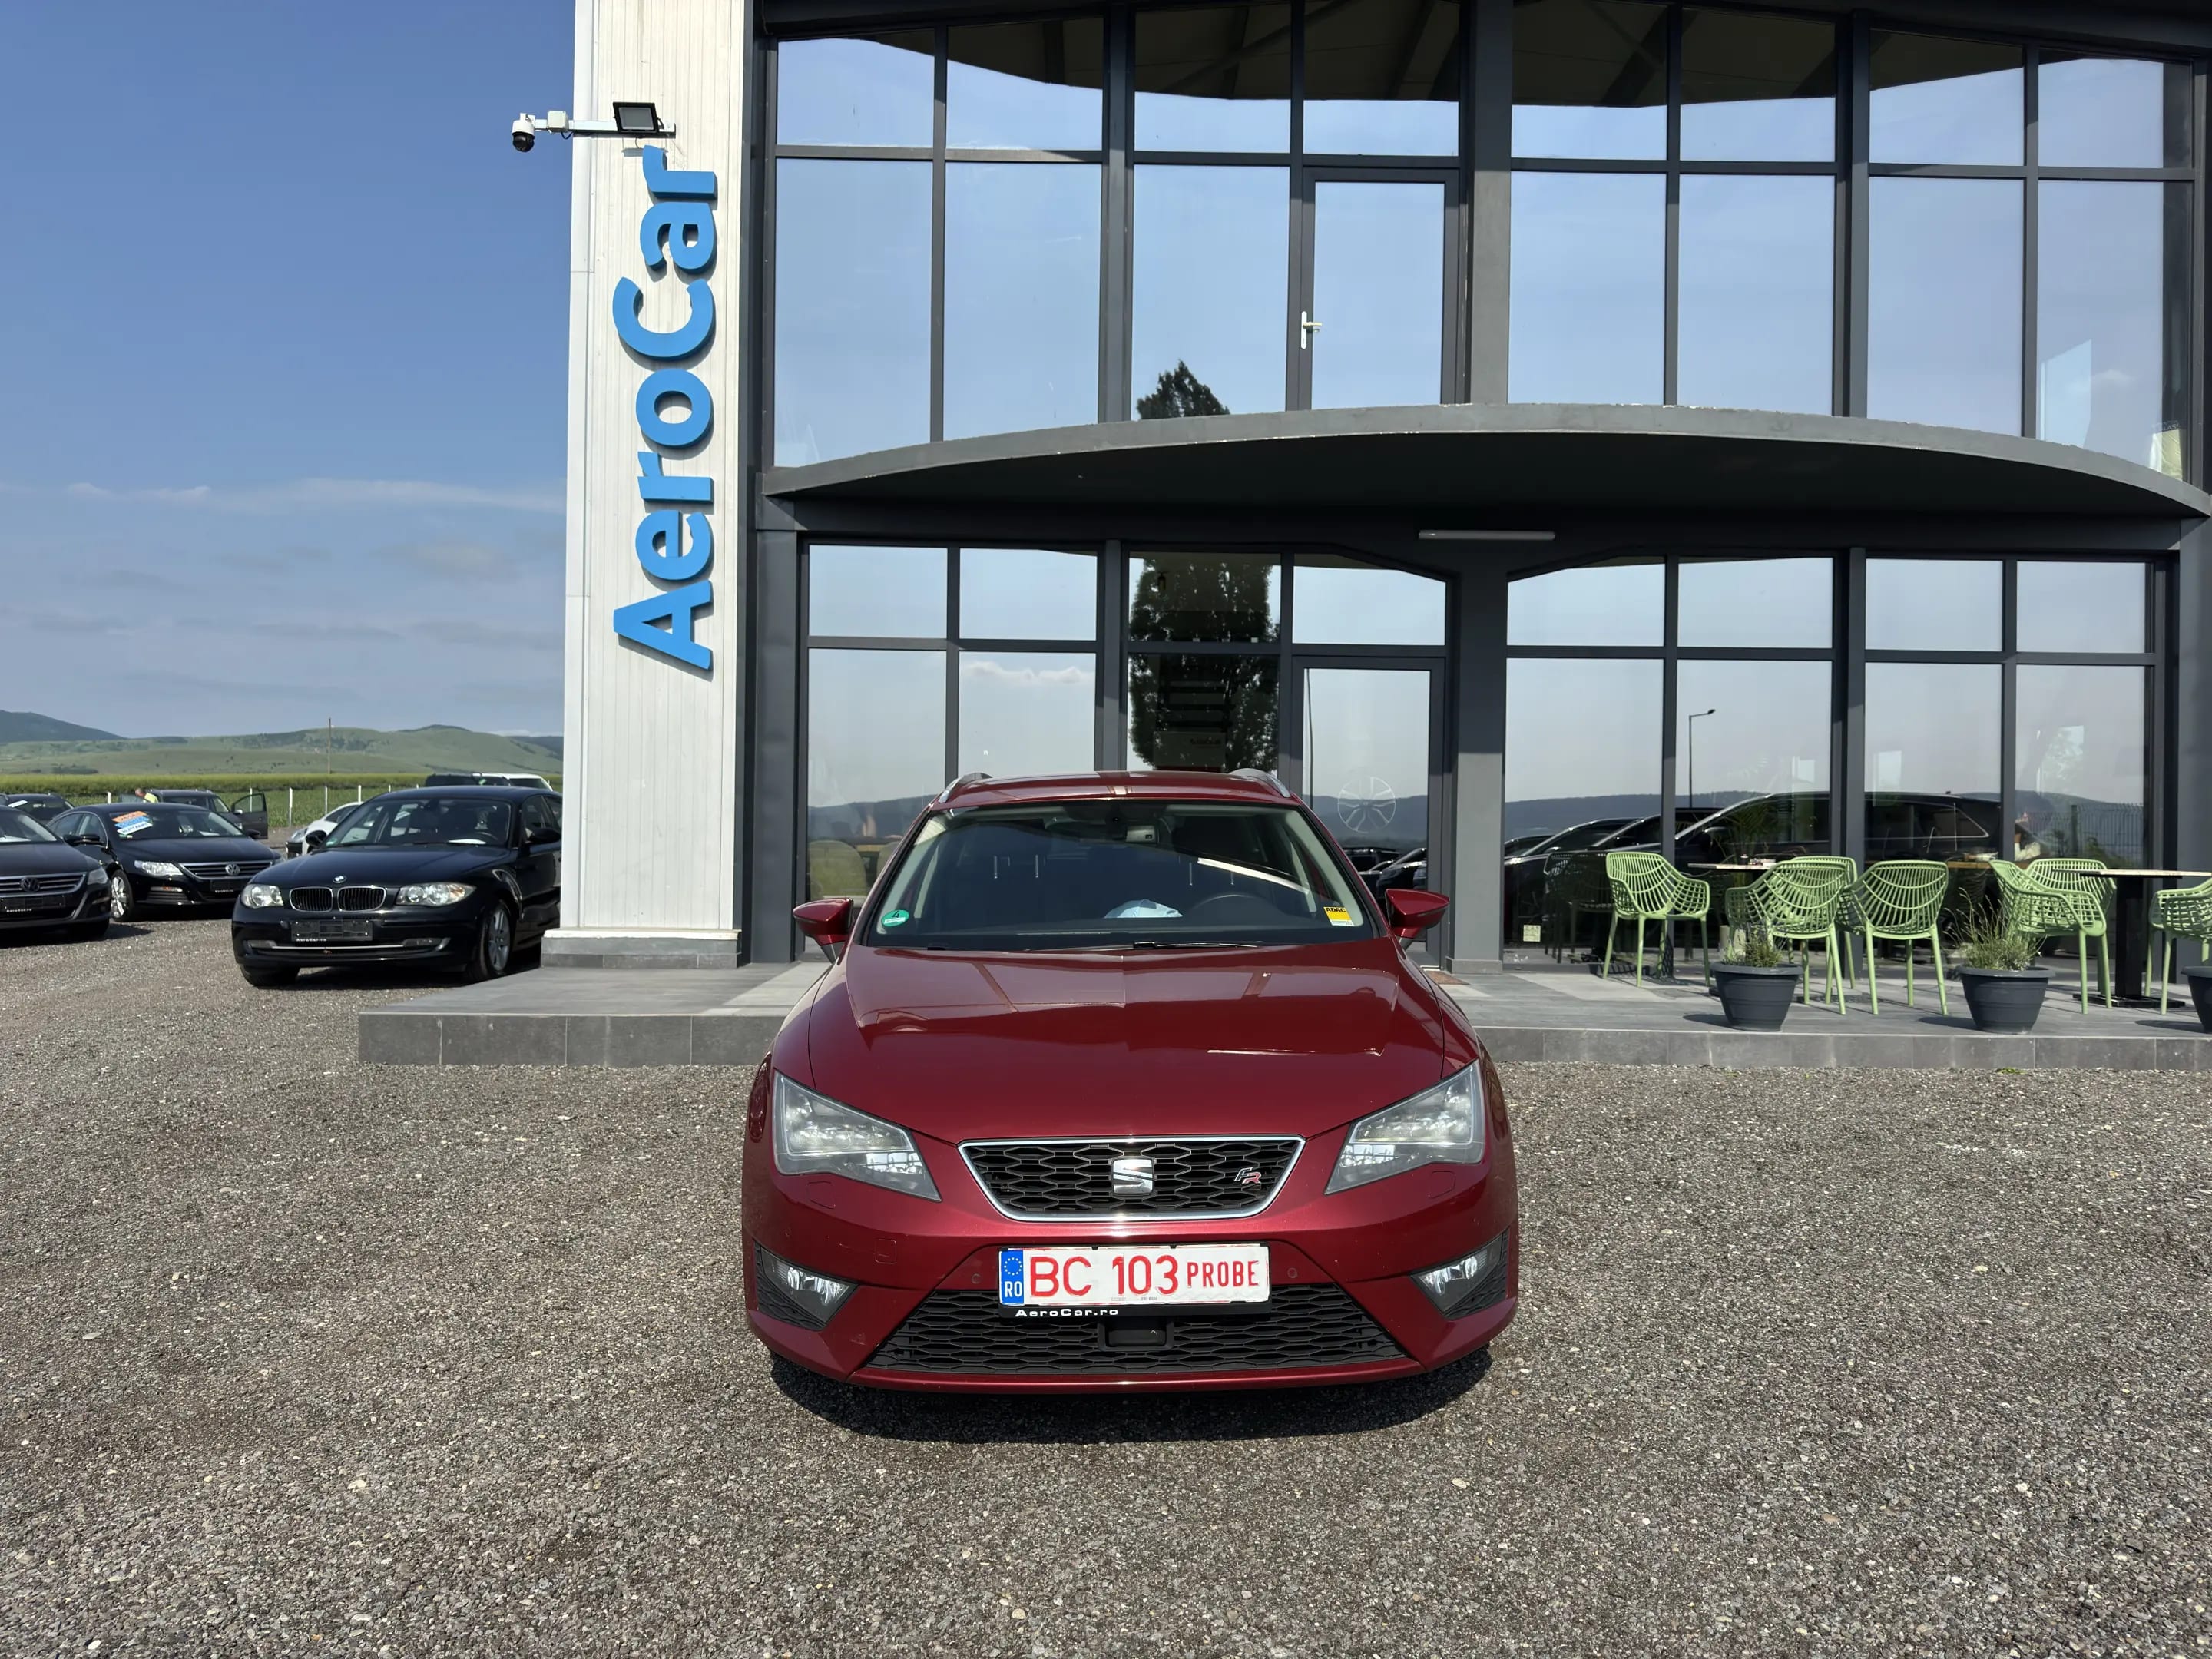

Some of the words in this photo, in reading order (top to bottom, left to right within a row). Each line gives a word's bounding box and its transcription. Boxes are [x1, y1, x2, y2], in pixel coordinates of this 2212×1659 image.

[613, 145, 717, 670] AeroCar
[1233, 1167, 1262, 1184] FR
[1030, 1256, 1092, 1297] BC
[1112, 1255, 1179, 1296] 103
[1187, 1260, 1259, 1288] PROBE
[1005, 1281, 1022, 1297] RO
[1015, 1308, 1118, 1317] AeroCar.ro
